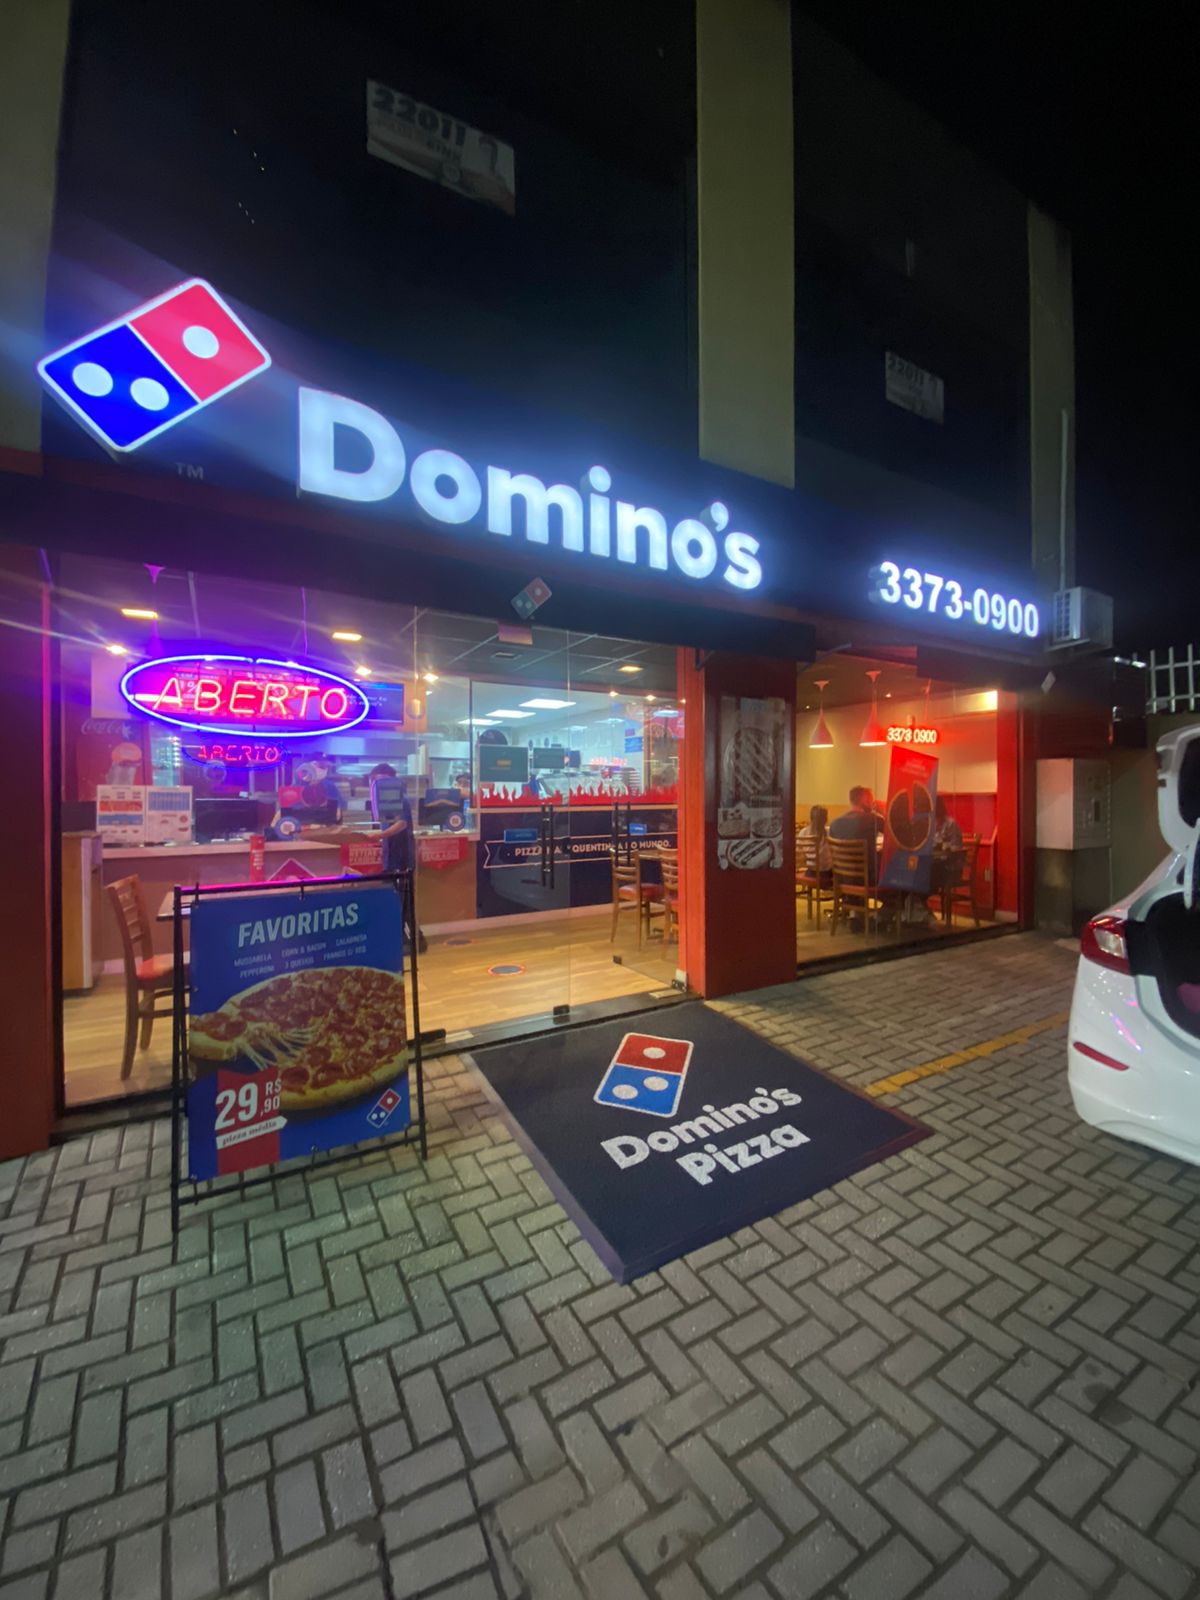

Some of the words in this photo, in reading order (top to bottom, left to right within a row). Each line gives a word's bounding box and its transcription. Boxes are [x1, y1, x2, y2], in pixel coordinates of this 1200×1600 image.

[176, 463, 204, 480] TM
[299, 386, 763, 590] Domino's
[880, 561, 1039, 638] 3373-0900
[154, 677, 348, 719] ABERTO
[197, 745, 280, 762] ABERTO
[238, 903, 359, 947] FAVORITAS
[215, 1082, 258, 1131] 29
[265, 1078, 282, 1095] R$
[600, 1087, 802, 1170] Domino's
[675, 1124, 811, 1186] Pizza
